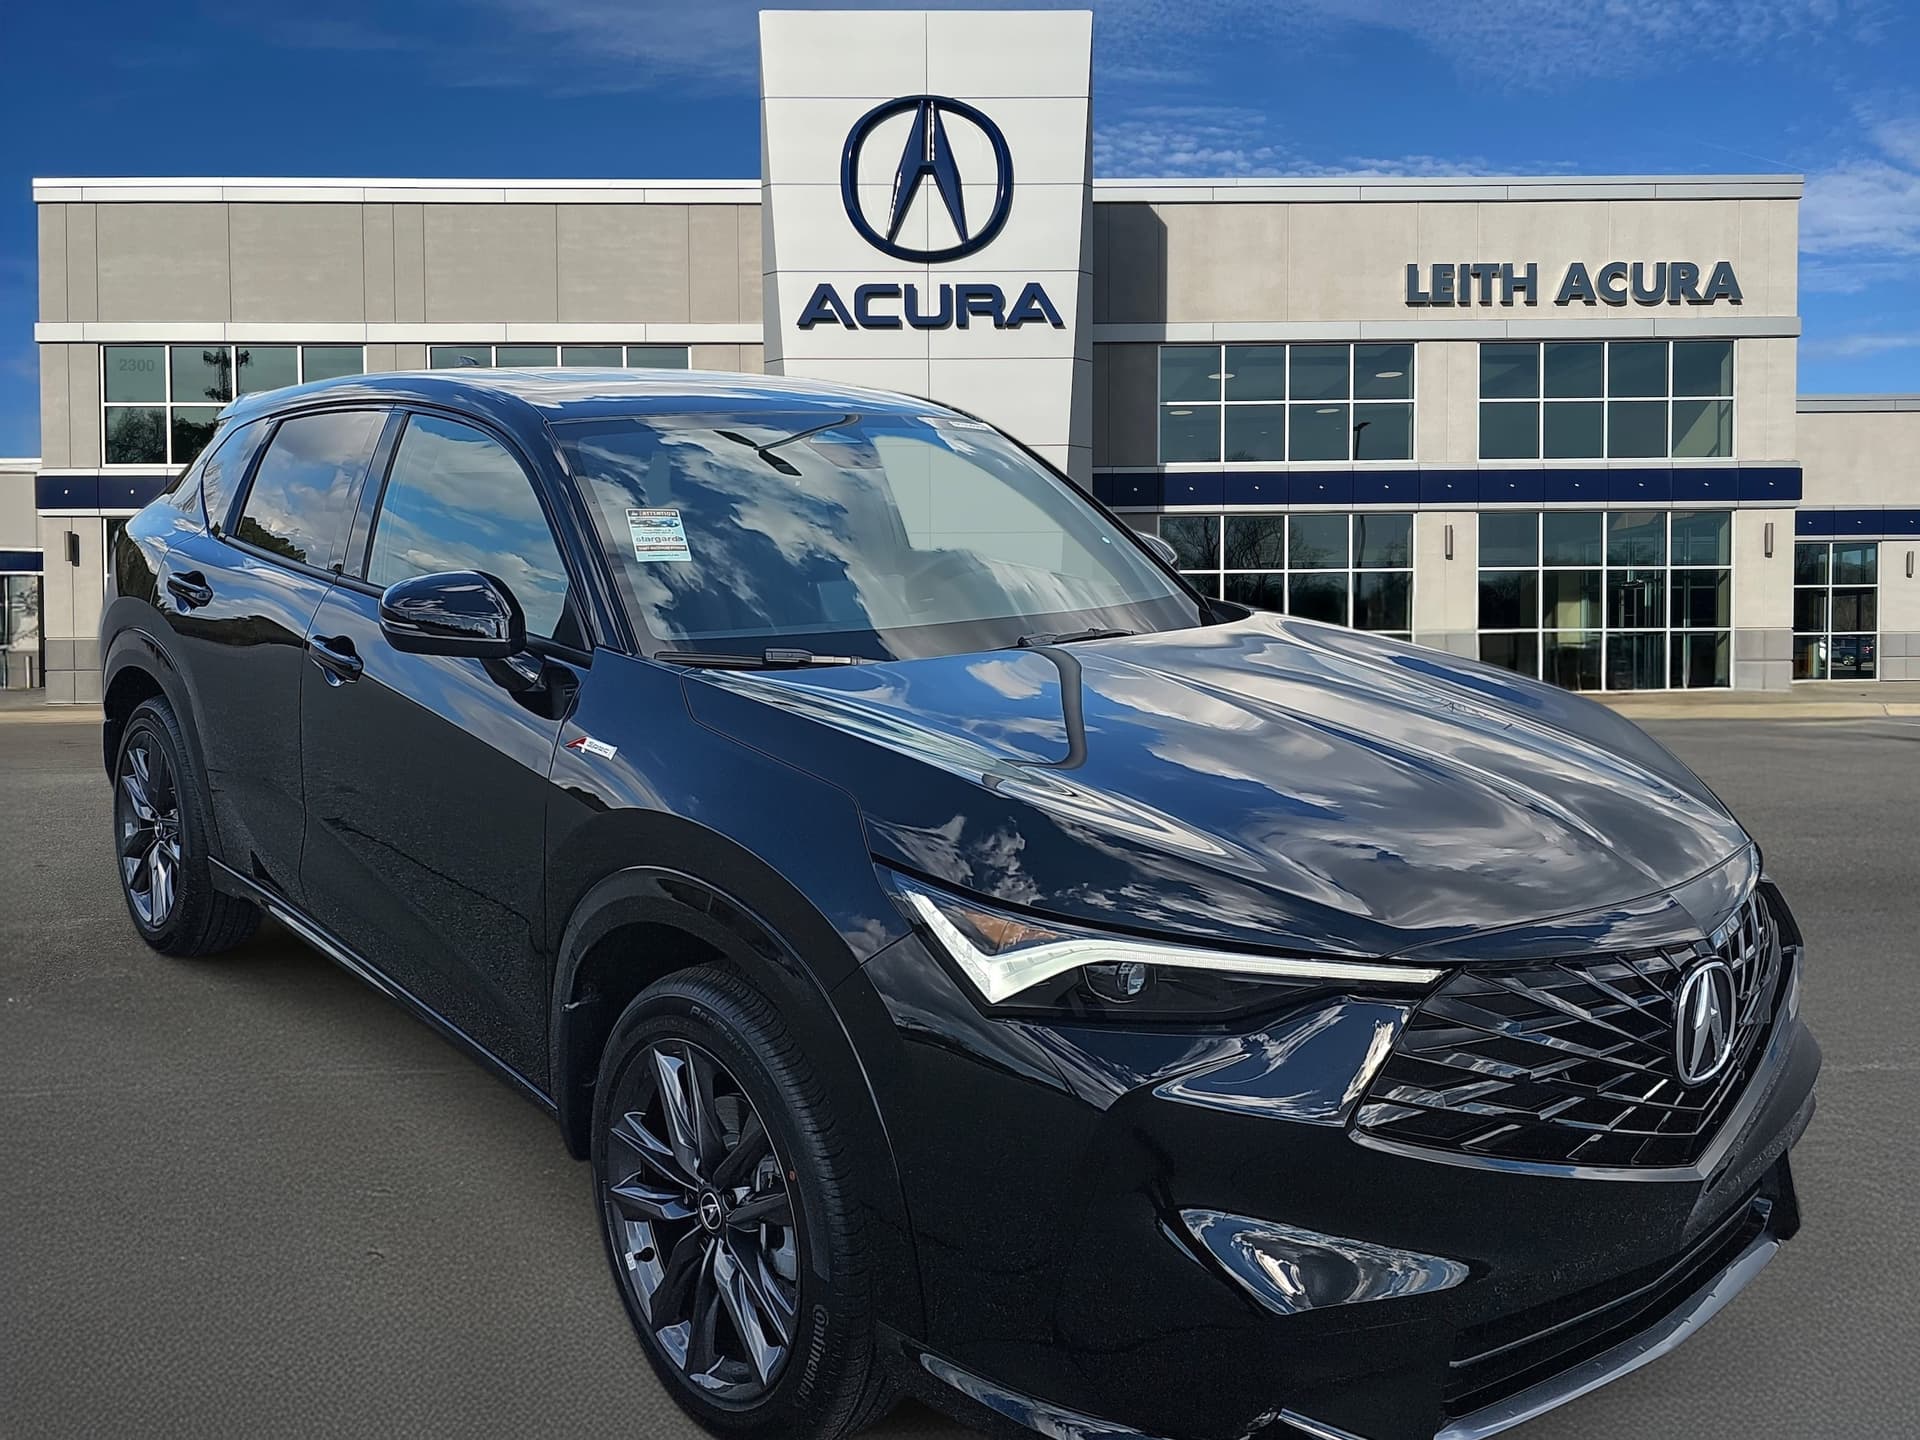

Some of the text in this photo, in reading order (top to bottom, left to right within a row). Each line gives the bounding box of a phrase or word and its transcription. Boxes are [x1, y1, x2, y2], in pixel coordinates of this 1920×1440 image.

[797, 282, 1067, 330] ACURA
[1405, 260, 1744, 307] LEITH ACURA
[119, 358, 154, 372] 2300
